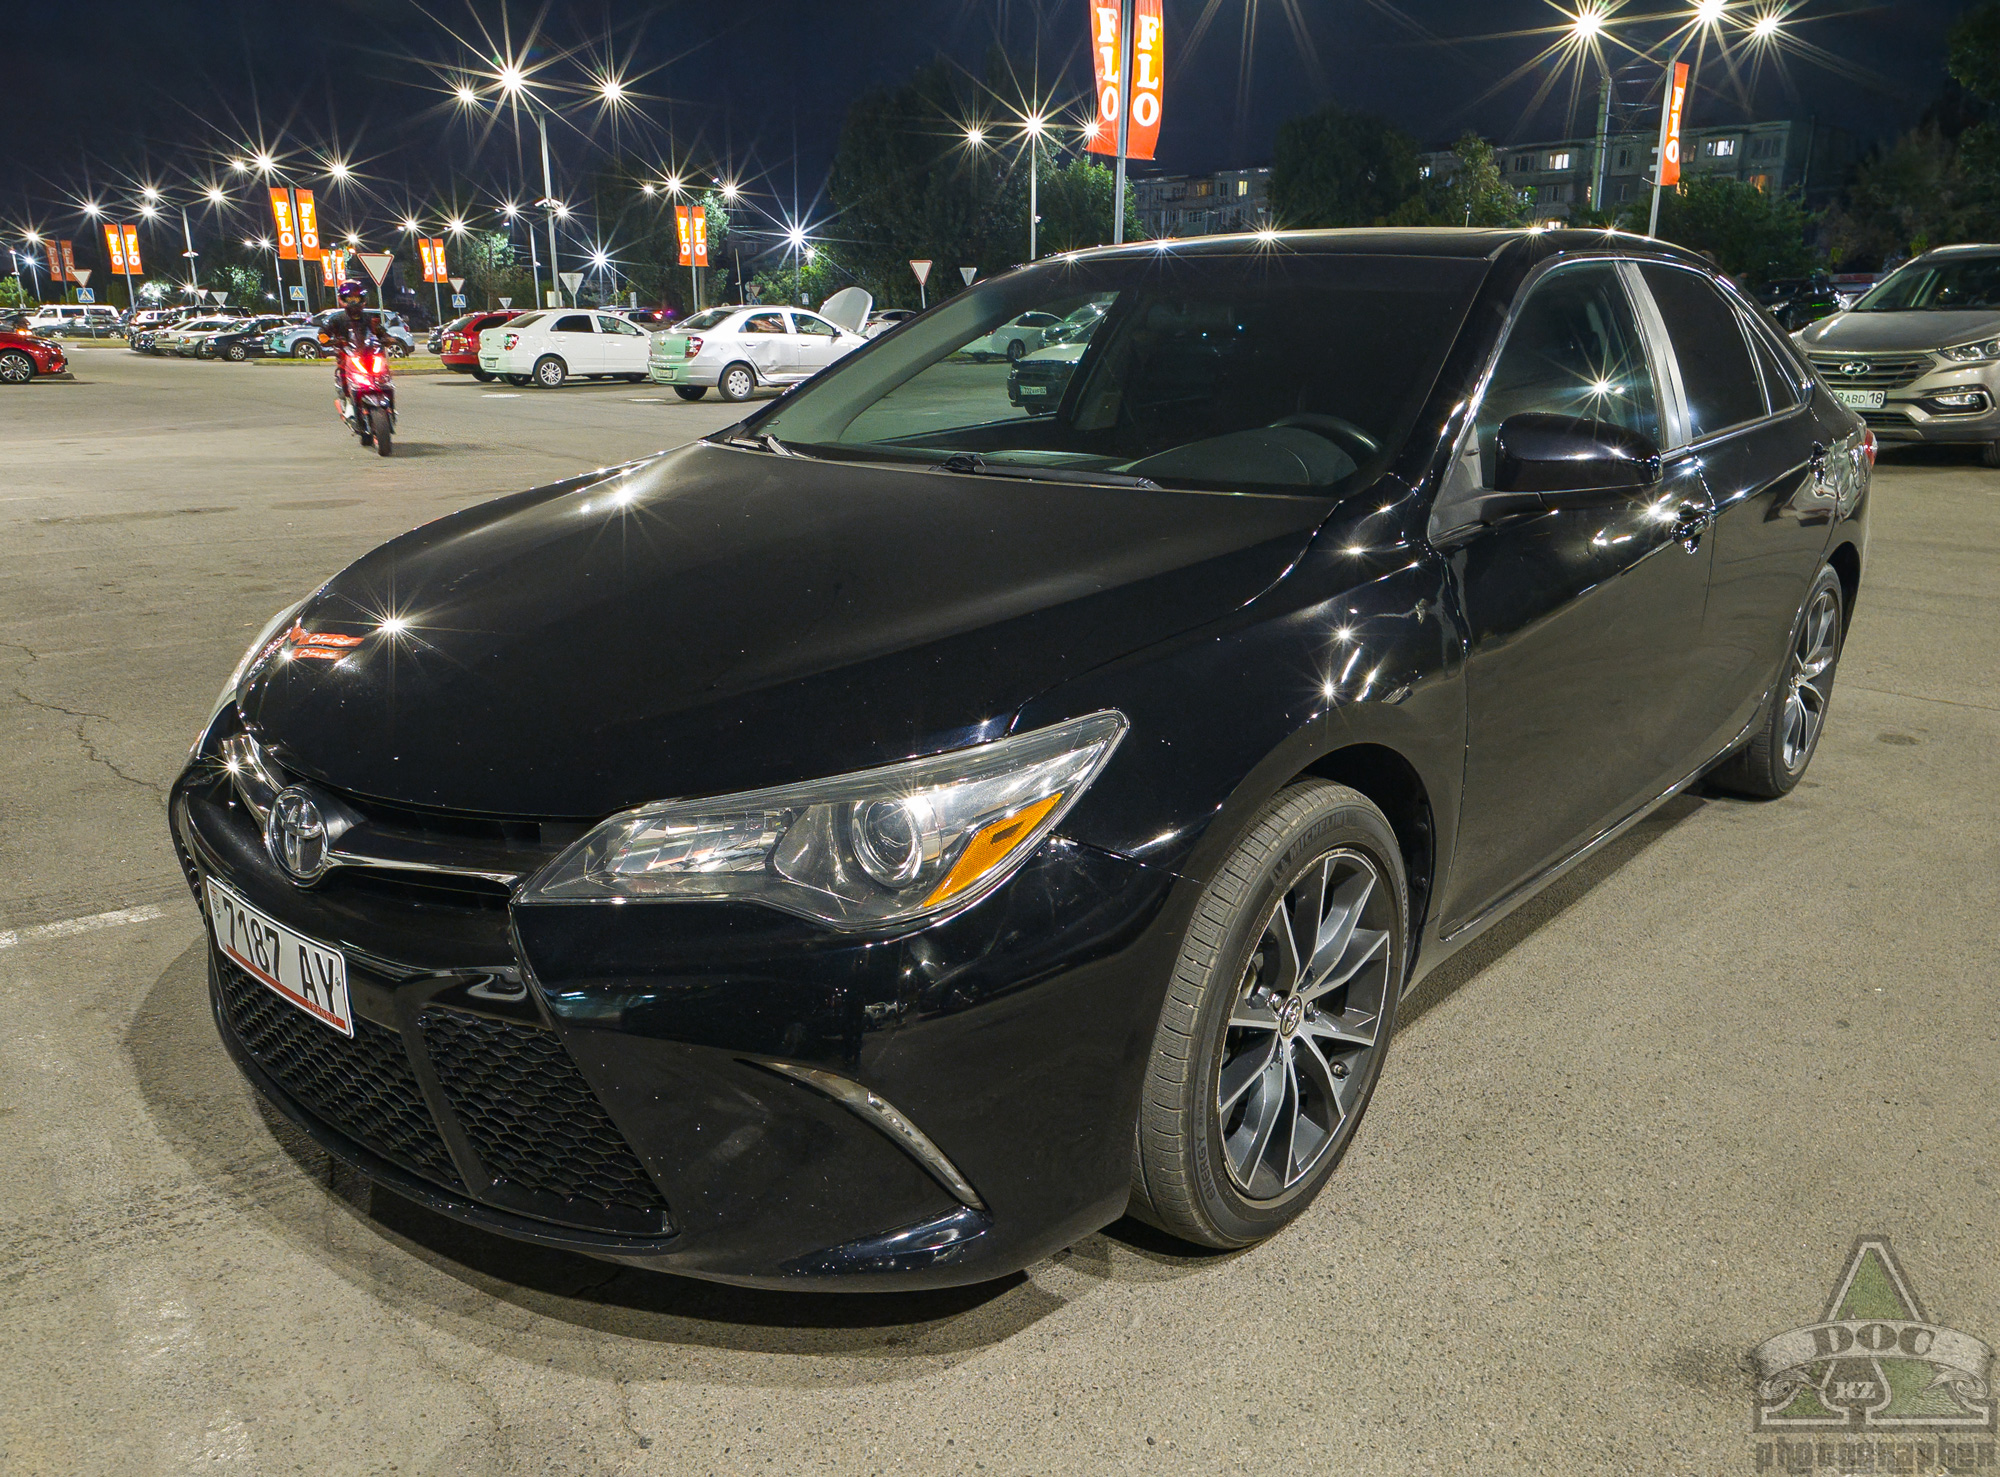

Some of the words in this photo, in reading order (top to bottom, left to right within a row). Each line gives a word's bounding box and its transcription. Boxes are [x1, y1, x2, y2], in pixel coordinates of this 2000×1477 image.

[1097, 8, 1118, 121] FLO
[1132, 15, 1159, 127] FLO
[1665, 86, 1684, 163] FLO
[275, 202, 295, 247] FLO
[300, 203, 318, 248] FLO
[678, 217, 691, 256] FLO
[694, 218, 707, 256] FLO
[48, 248, 61, 274] FLO
[63, 248, 76, 274] FLO
[108, 234, 124, 266] FLO
[126, 234, 141, 266] FLO
[1869, 392, 1883, 404] 18
[1289, 810, 1348, 862] MICHELIN
[222, 896, 281, 981] 7187
[298, 944, 335, 1013] AY
